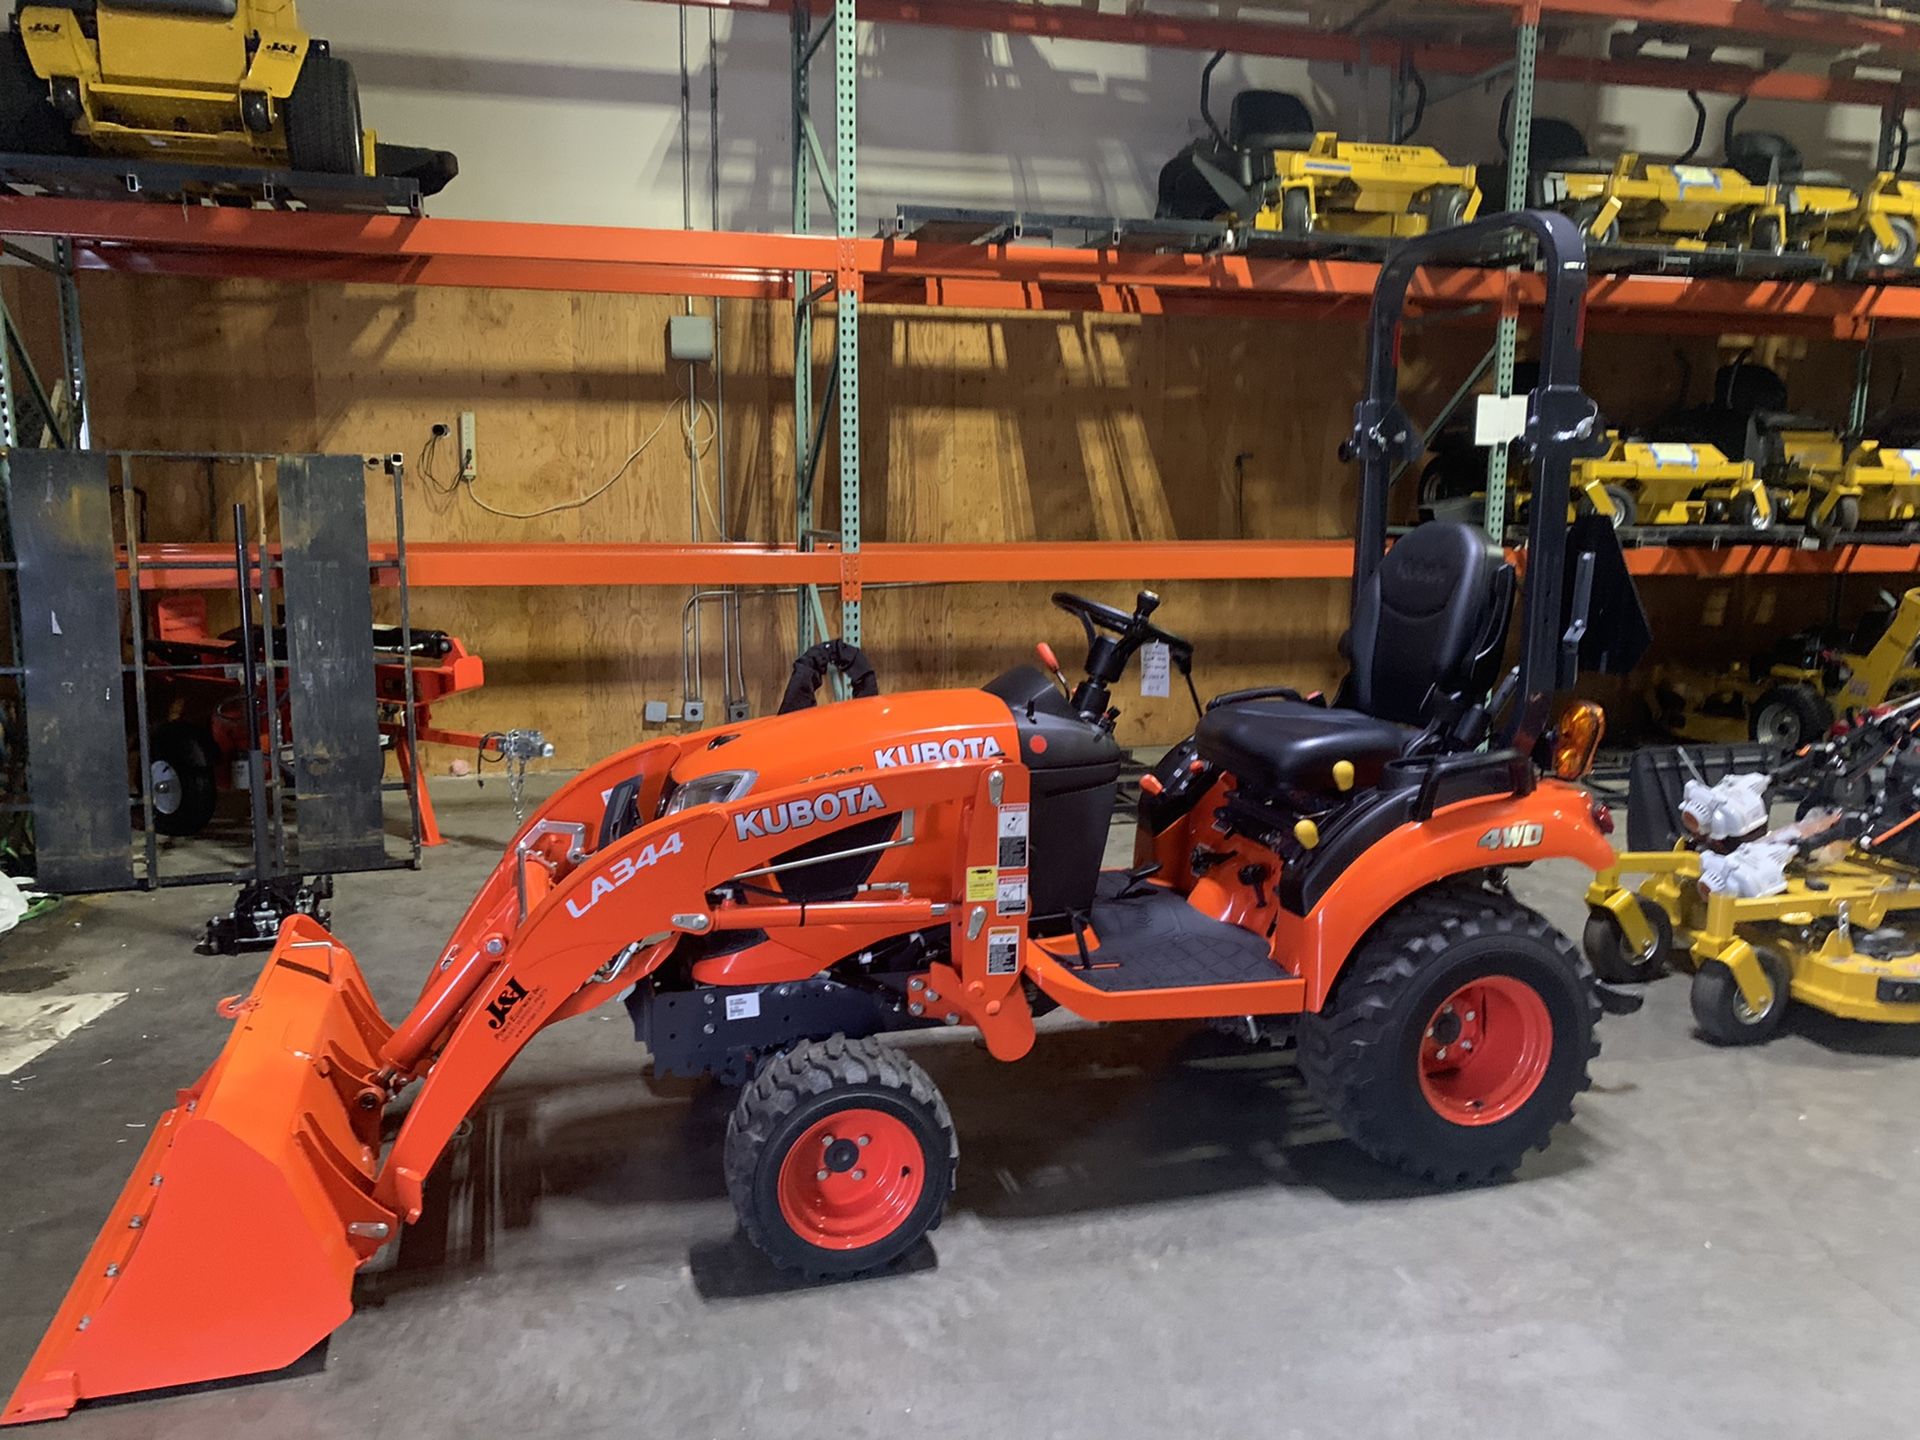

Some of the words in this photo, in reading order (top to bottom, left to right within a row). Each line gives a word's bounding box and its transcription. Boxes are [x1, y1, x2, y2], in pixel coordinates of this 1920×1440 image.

[874, 736, 1003, 769] KUBOTA
[734, 784, 886, 841] KUBOTA
[1477, 823, 1544, 851] 4WD
[565, 832, 684, 918] LA344
[485, 976, 530, 1030] J&I
